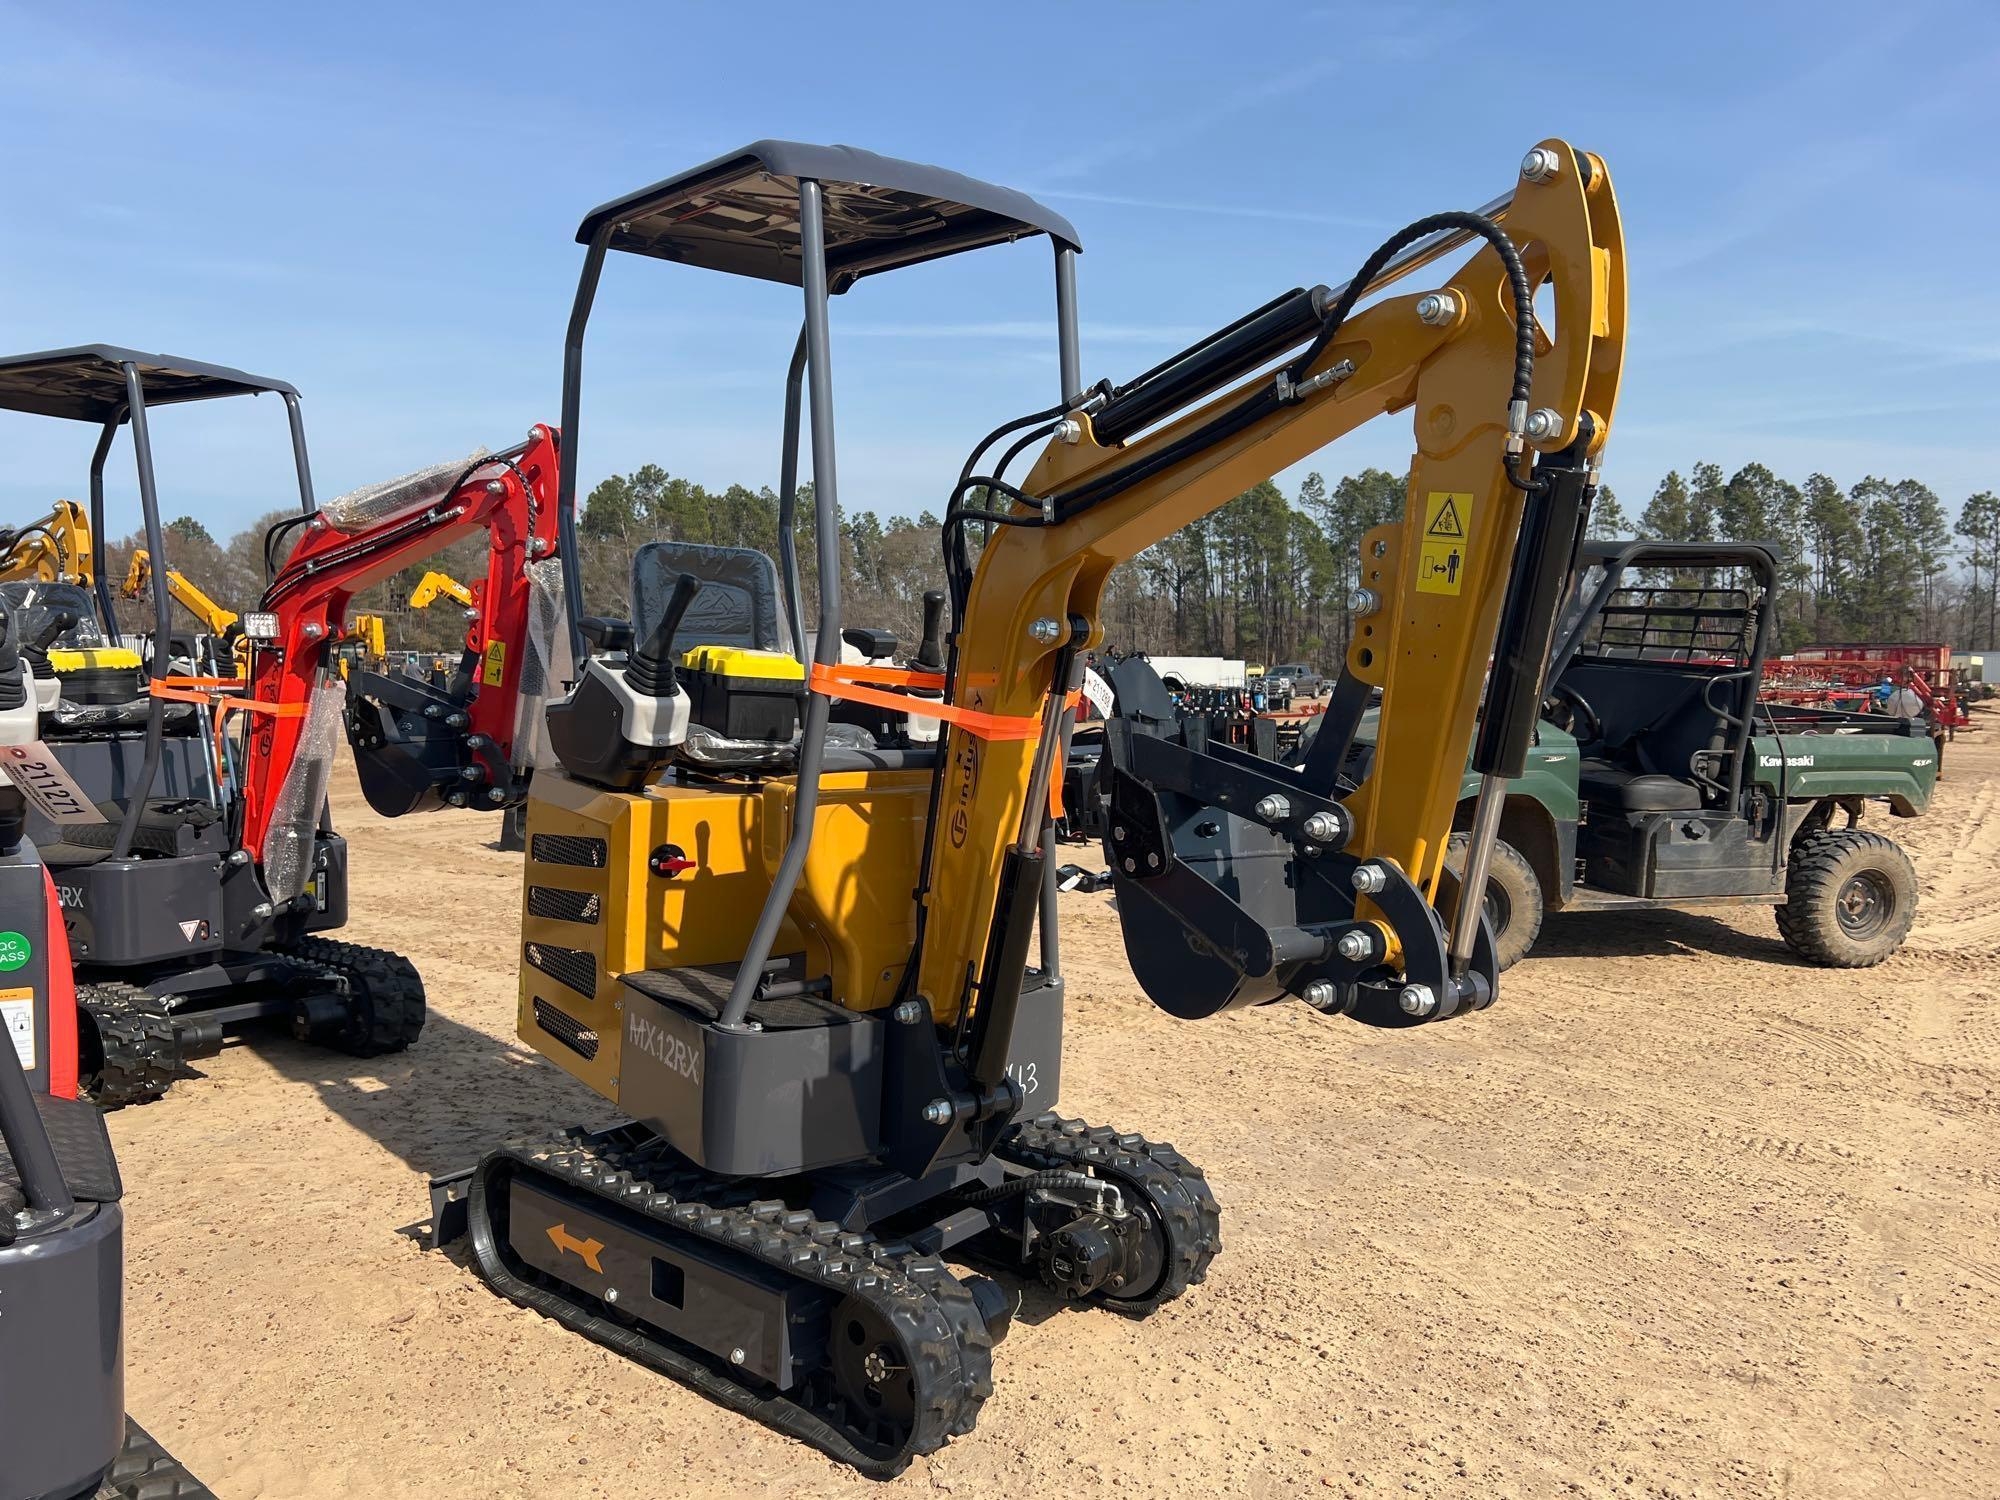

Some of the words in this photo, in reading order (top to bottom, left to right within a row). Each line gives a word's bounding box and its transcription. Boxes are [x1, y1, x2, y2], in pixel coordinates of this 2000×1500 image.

[1760, 755, 1814, 767] Kawasaki
[951, 690, 982, 849] Gindusy
[20, 762, 86, 815] 211271
[0, 941, 17, 951] QC
[0, 951, 26, 962] ASS
